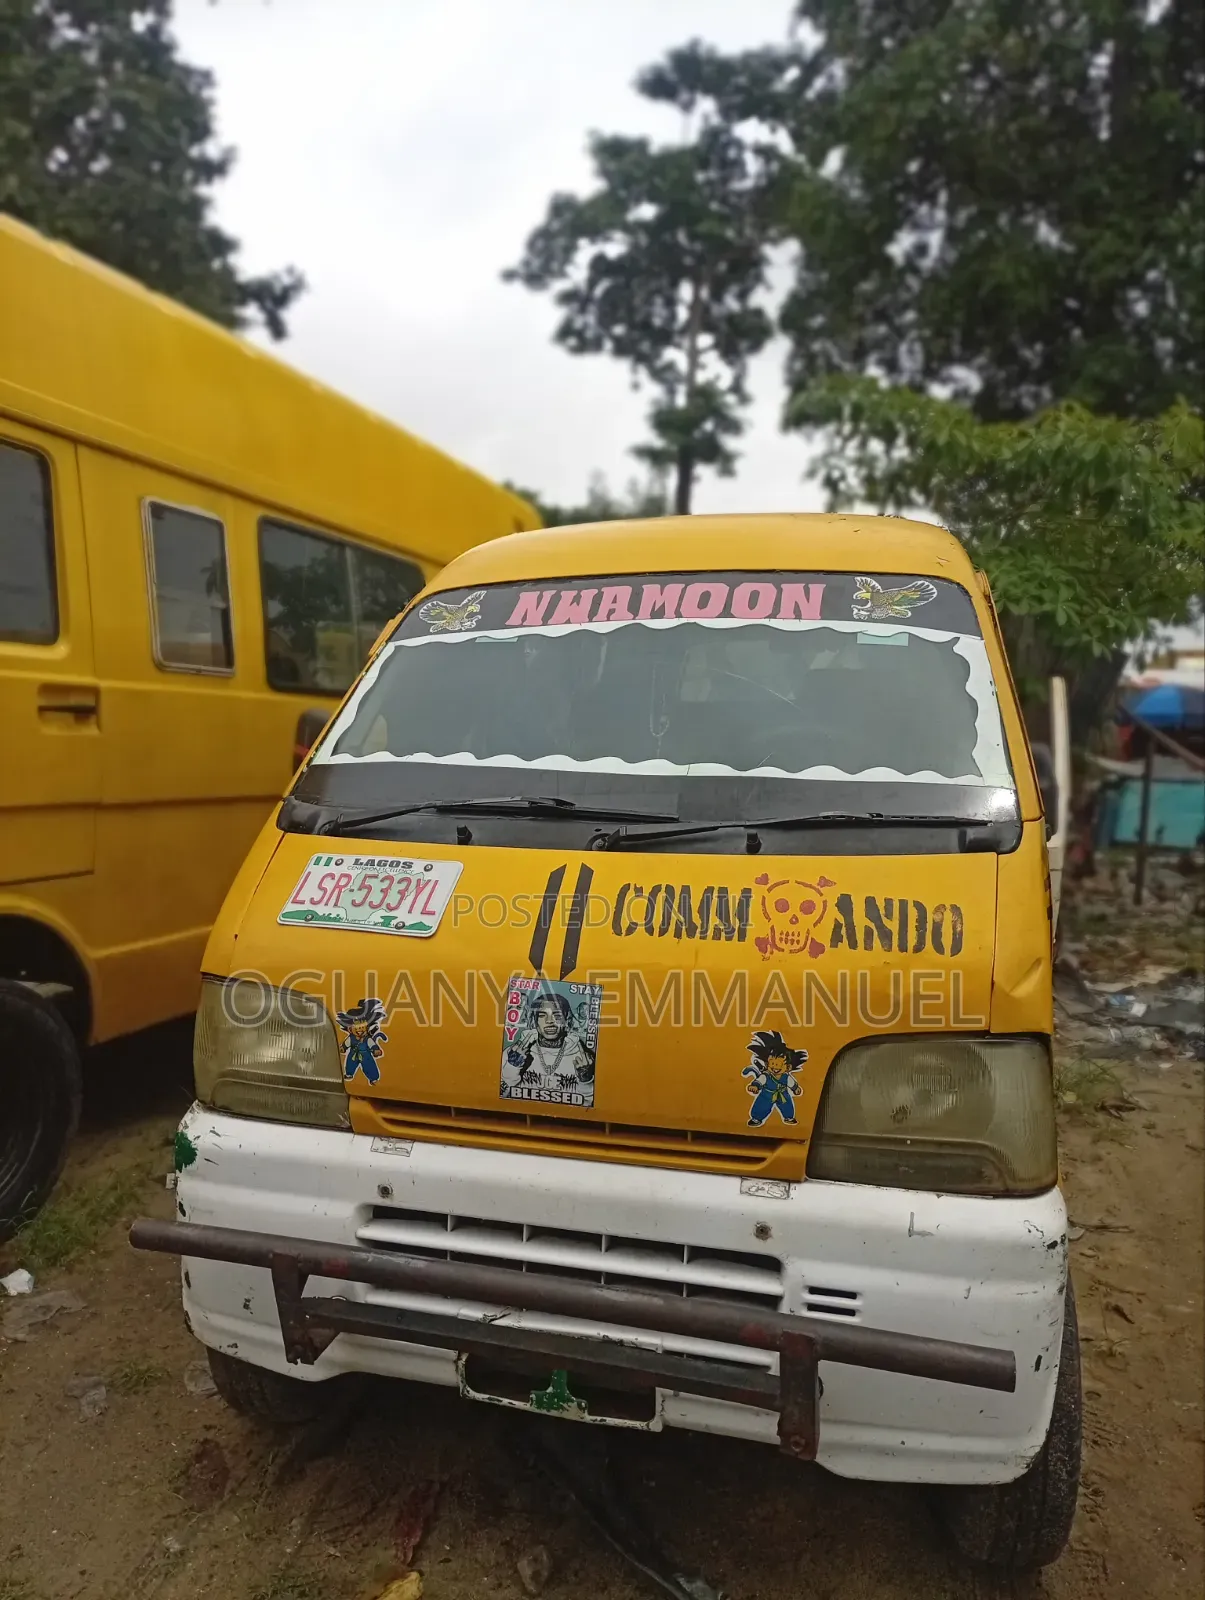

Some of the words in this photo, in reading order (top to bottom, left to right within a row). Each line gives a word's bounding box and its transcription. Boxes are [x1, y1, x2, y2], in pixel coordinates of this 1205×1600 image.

[504, 582, 826, 626] NWAMOON
[353, 858, 414, 869] LAGOS
[291, 871, 440, 916] LSR-533YL
[510, 979, 540, 990] STAR
[505, 990, 521, 1042] BOY
[569, 984, 601, 995] STAY
[586, 996, 600, 1049] BLESSED
[510, 1086, 584, 1105] BLESSED
